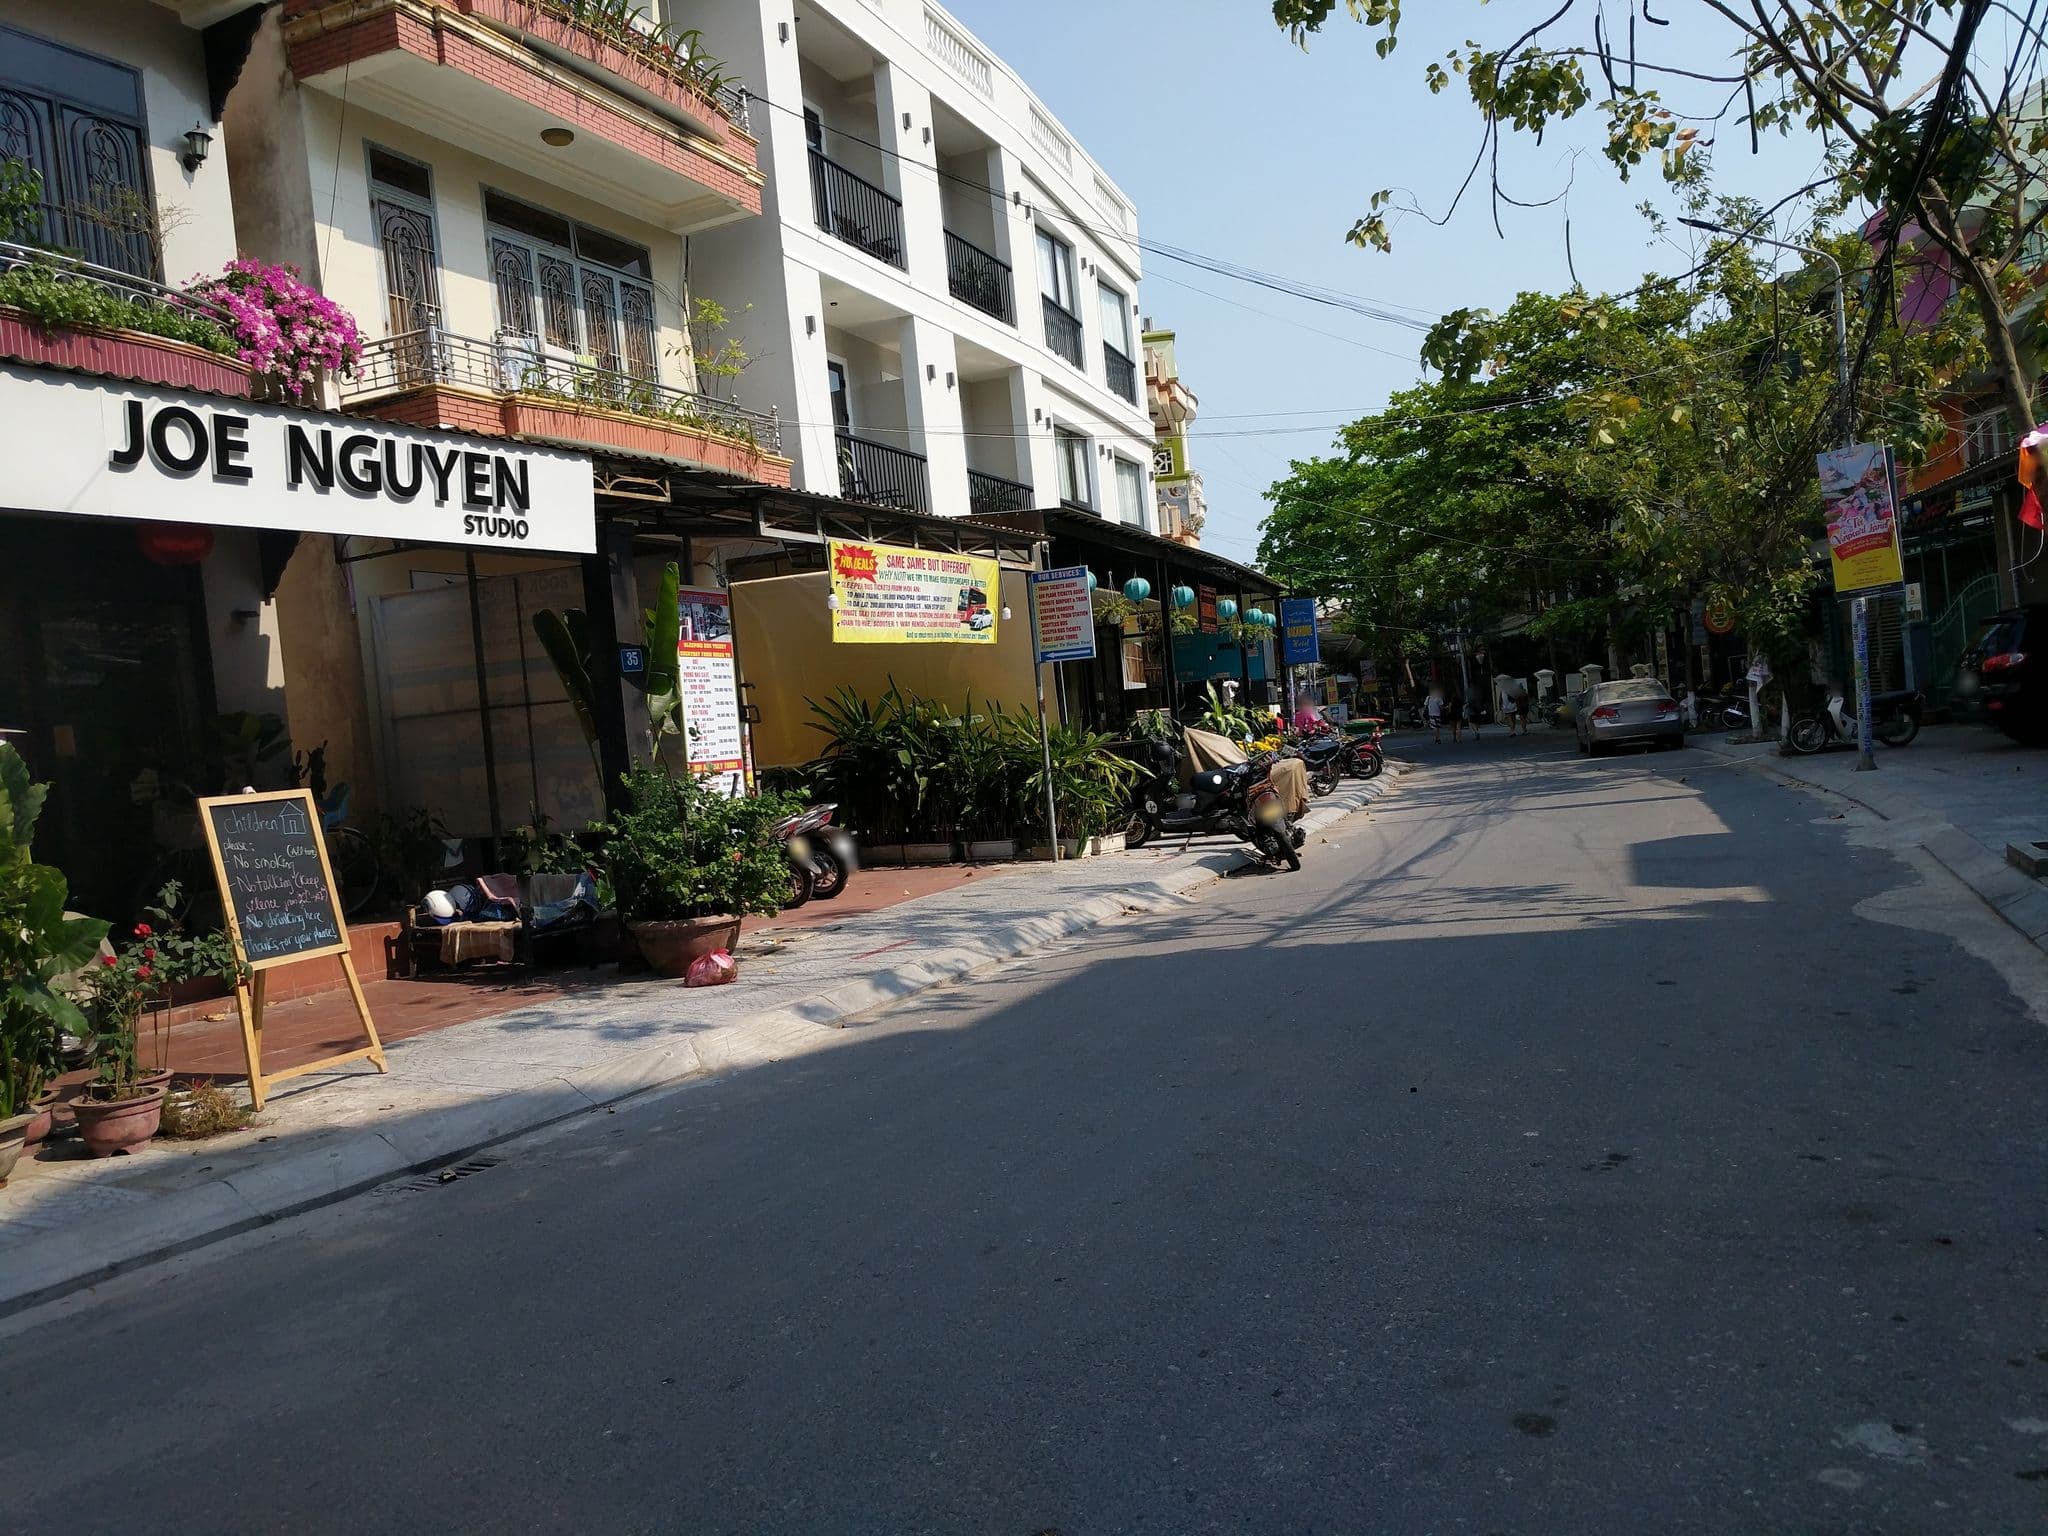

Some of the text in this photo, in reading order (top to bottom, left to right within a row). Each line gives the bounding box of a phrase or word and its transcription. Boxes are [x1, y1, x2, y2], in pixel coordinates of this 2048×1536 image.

[109, 400, 530, 510] JOE NGUYEN
[464, 514, 529, 540] STUDIO
[854, 558, 874, 571] DEALS
[886, 555, 971, 574] SAME SAME BUT DIFFERENT
[879, 570, 893, 580] WHY
[907, 573, 915, 581] WE
[626, 651, 639, 666] 35
[234, 853, 296, 876] No smoking
[245, 913, 263, 929] No
